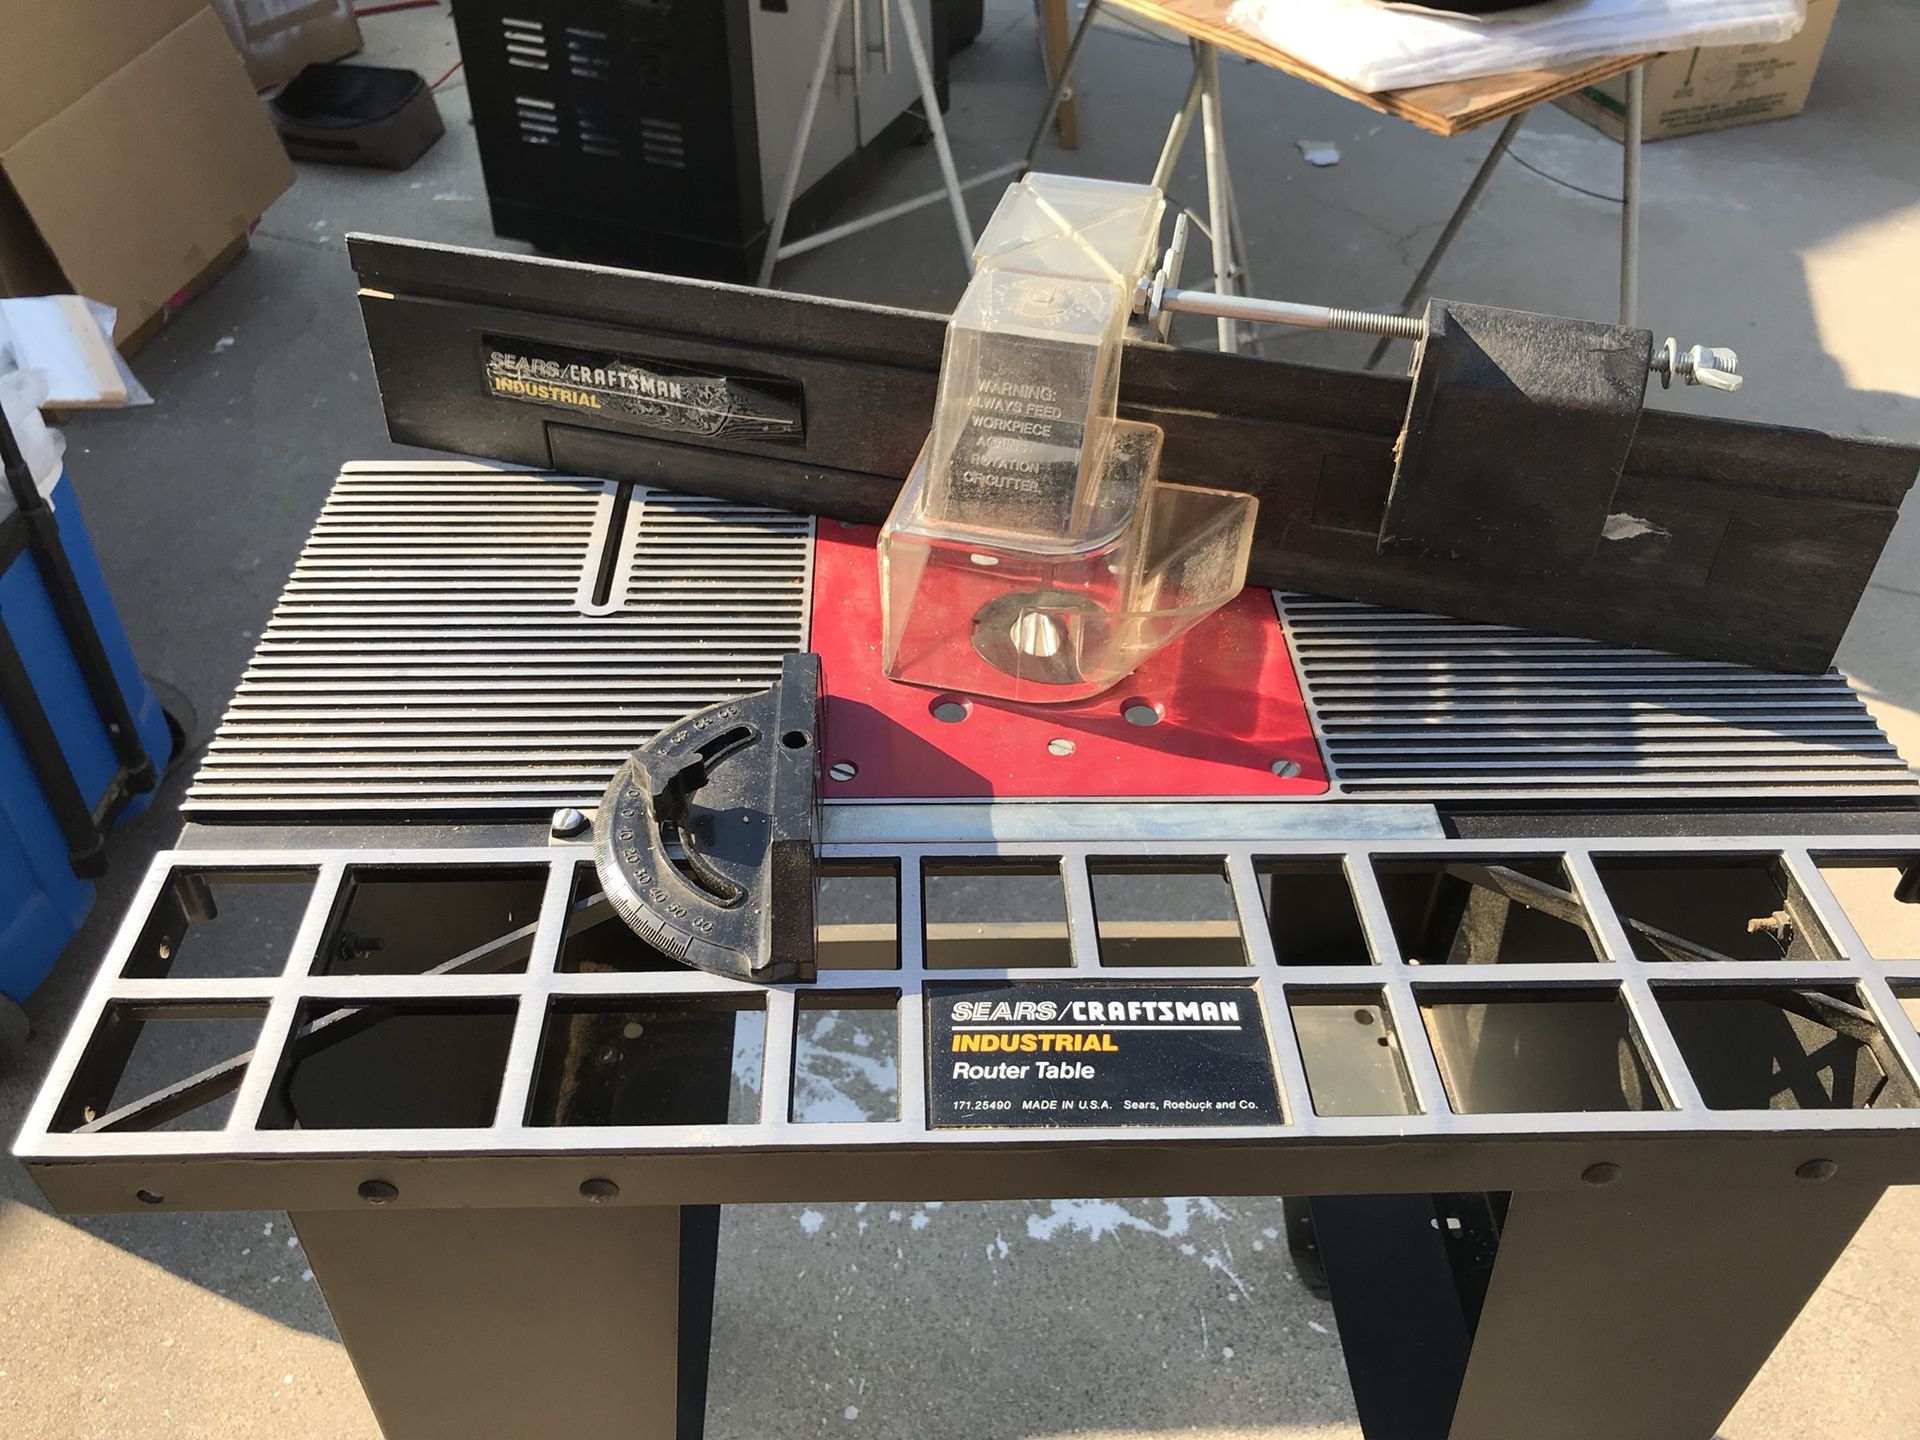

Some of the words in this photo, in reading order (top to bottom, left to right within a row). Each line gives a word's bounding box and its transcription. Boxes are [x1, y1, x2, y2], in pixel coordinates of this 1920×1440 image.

[495, 377, 602, 409] INDUSTRIAL
[978, 379, 1057, 402] WARNING:
[967, 395, 1022, 414] ALWAYS
[1026, 403, 1062, 419] FEED
[972, 414, 1051, 437] WORKPIECE
[976, 435, 1033, 453] AGAINST
[971, 453, 1041, 474] ROTATION
[963, 470, 982, 484] OF
[619, 829, 634, 841] 10
[623, 848, 641, 864] 20
[633, 867, 652, 885] 30
[649, 887, 668, 904] 40
[667, 902, 687, 919] 50
[692, 915, 714, 933] 60
[951, 1000, 1240, 1022] SEARS/CRAFTSMAN
[951, 1033, 1119, 1052] INDUSTRIAL
[952, 1062, 1030, 1080] Router
[1035, 1061, 1096, 1080] Table
[952, 1100, 1012, 1111] 171.25490
[1022, 1100, 1057, 1110] MADE
[1061, 1100, 1074, 1110] IN
[1079, 1100, 1113, 1110] U.S.A.
[1124, 1100, 1160, 1112] Sears,
[1163, 1099, 1212, 1111] Roebuck
[1215, 1100, 1236, 1110] and
[1239, 1100, 1259, 1110] Co.
